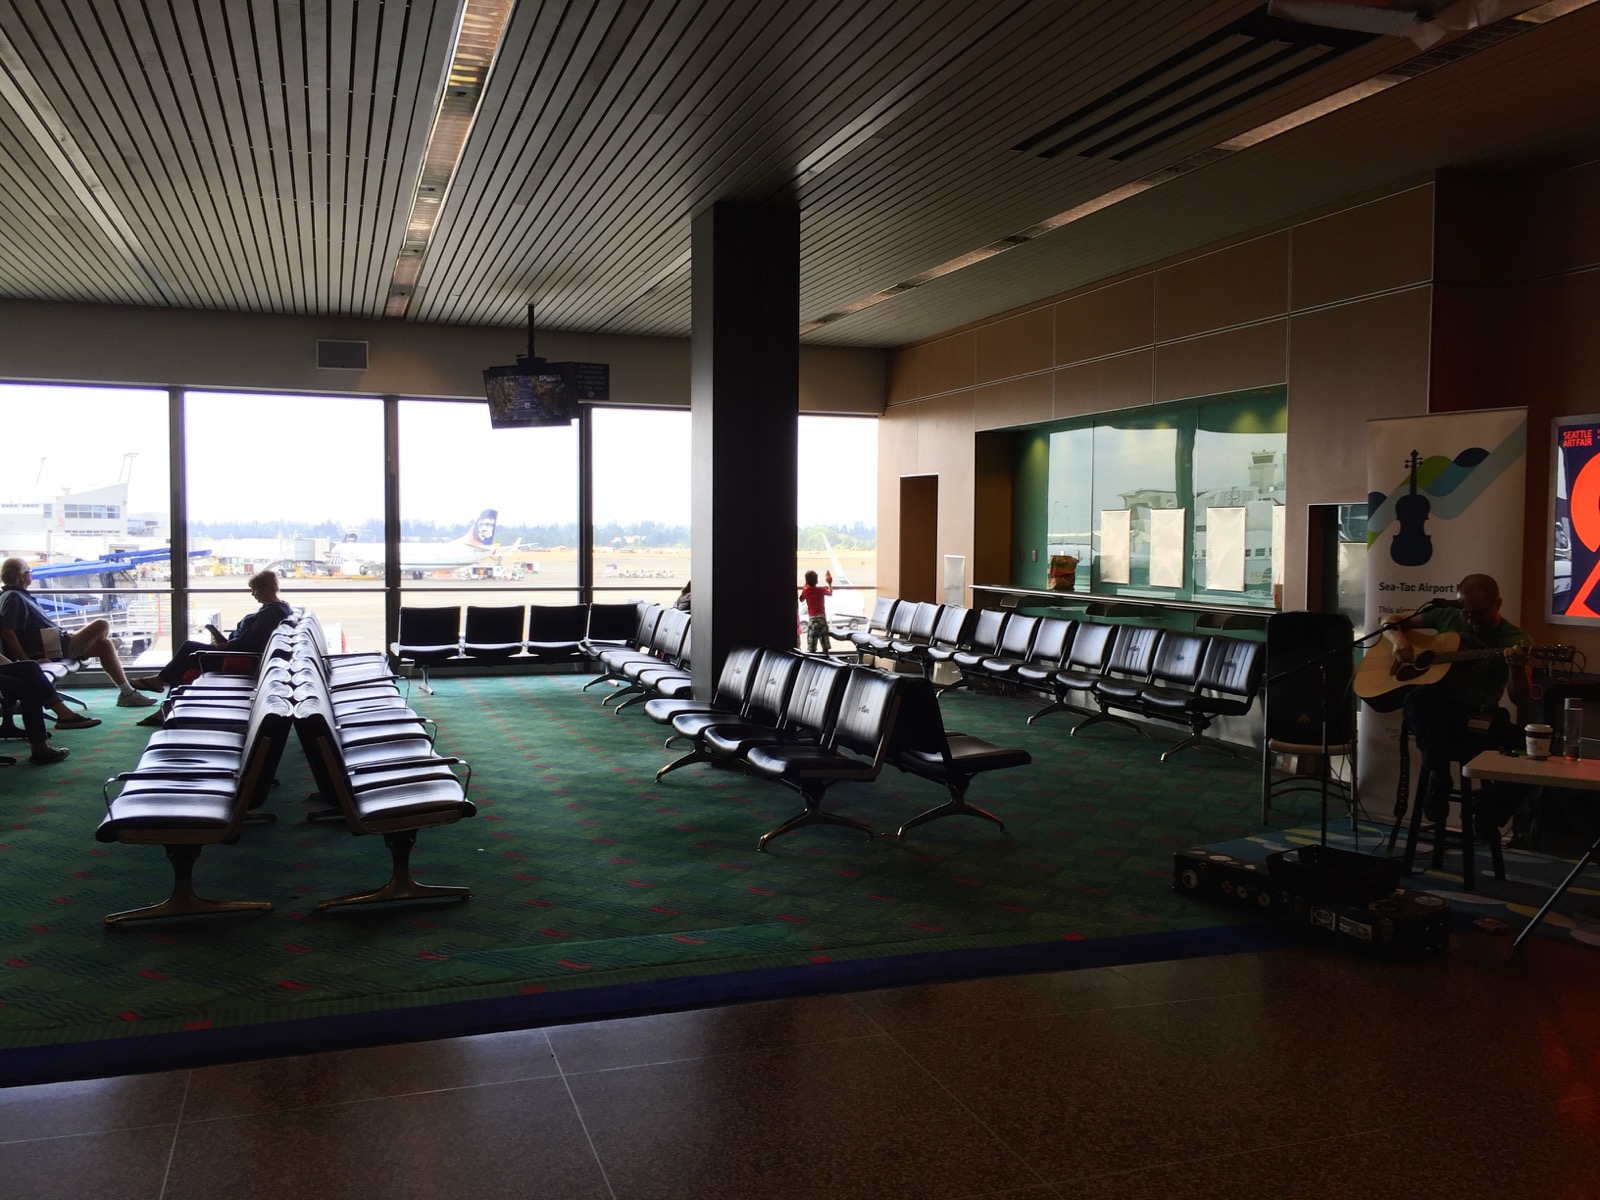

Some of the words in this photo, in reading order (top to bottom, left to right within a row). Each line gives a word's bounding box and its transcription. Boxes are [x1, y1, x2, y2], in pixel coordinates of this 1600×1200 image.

[1563, 429, 1593, 439] SEATTLE
[1379, 582, 1416, 592] Sea-Tac
[1418, 583, 1454, 594] Airport
[1378, 606, 1394, 614] This
